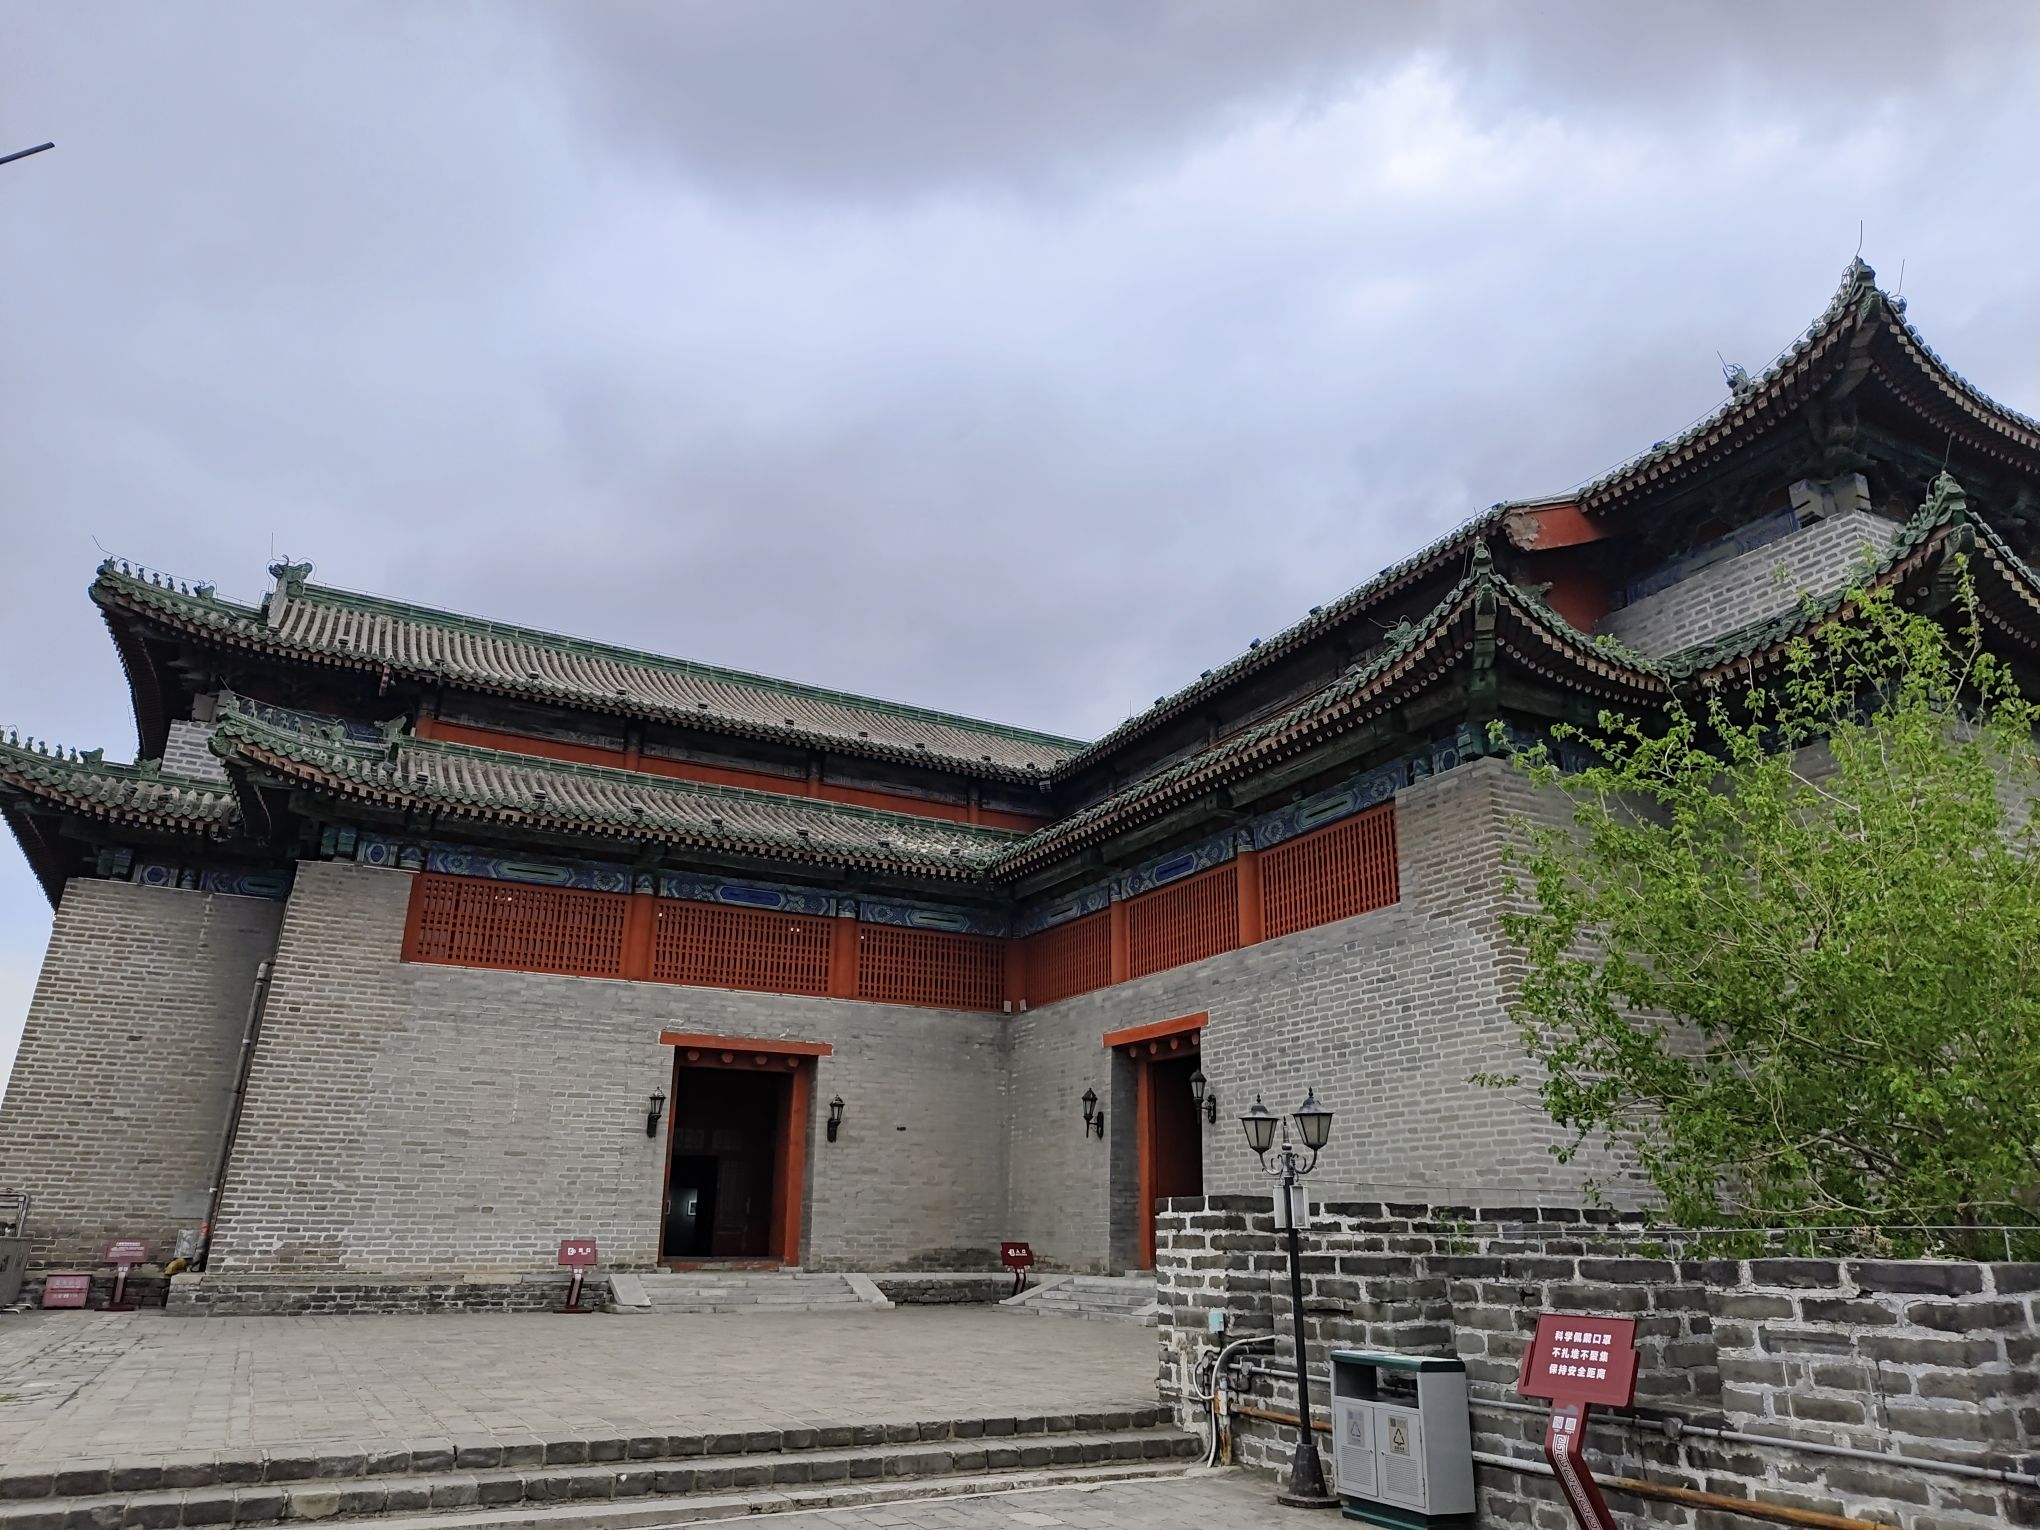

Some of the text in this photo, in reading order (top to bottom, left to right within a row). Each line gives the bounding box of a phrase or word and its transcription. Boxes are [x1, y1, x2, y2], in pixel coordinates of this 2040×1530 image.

[1554, 1330, 1612, 1345] 科学佩戴口罩
[1551, 1347, 1609, 1362] 不扎堆不聚集
[1549, 1363, 1606, 1379] 保持安全距离
